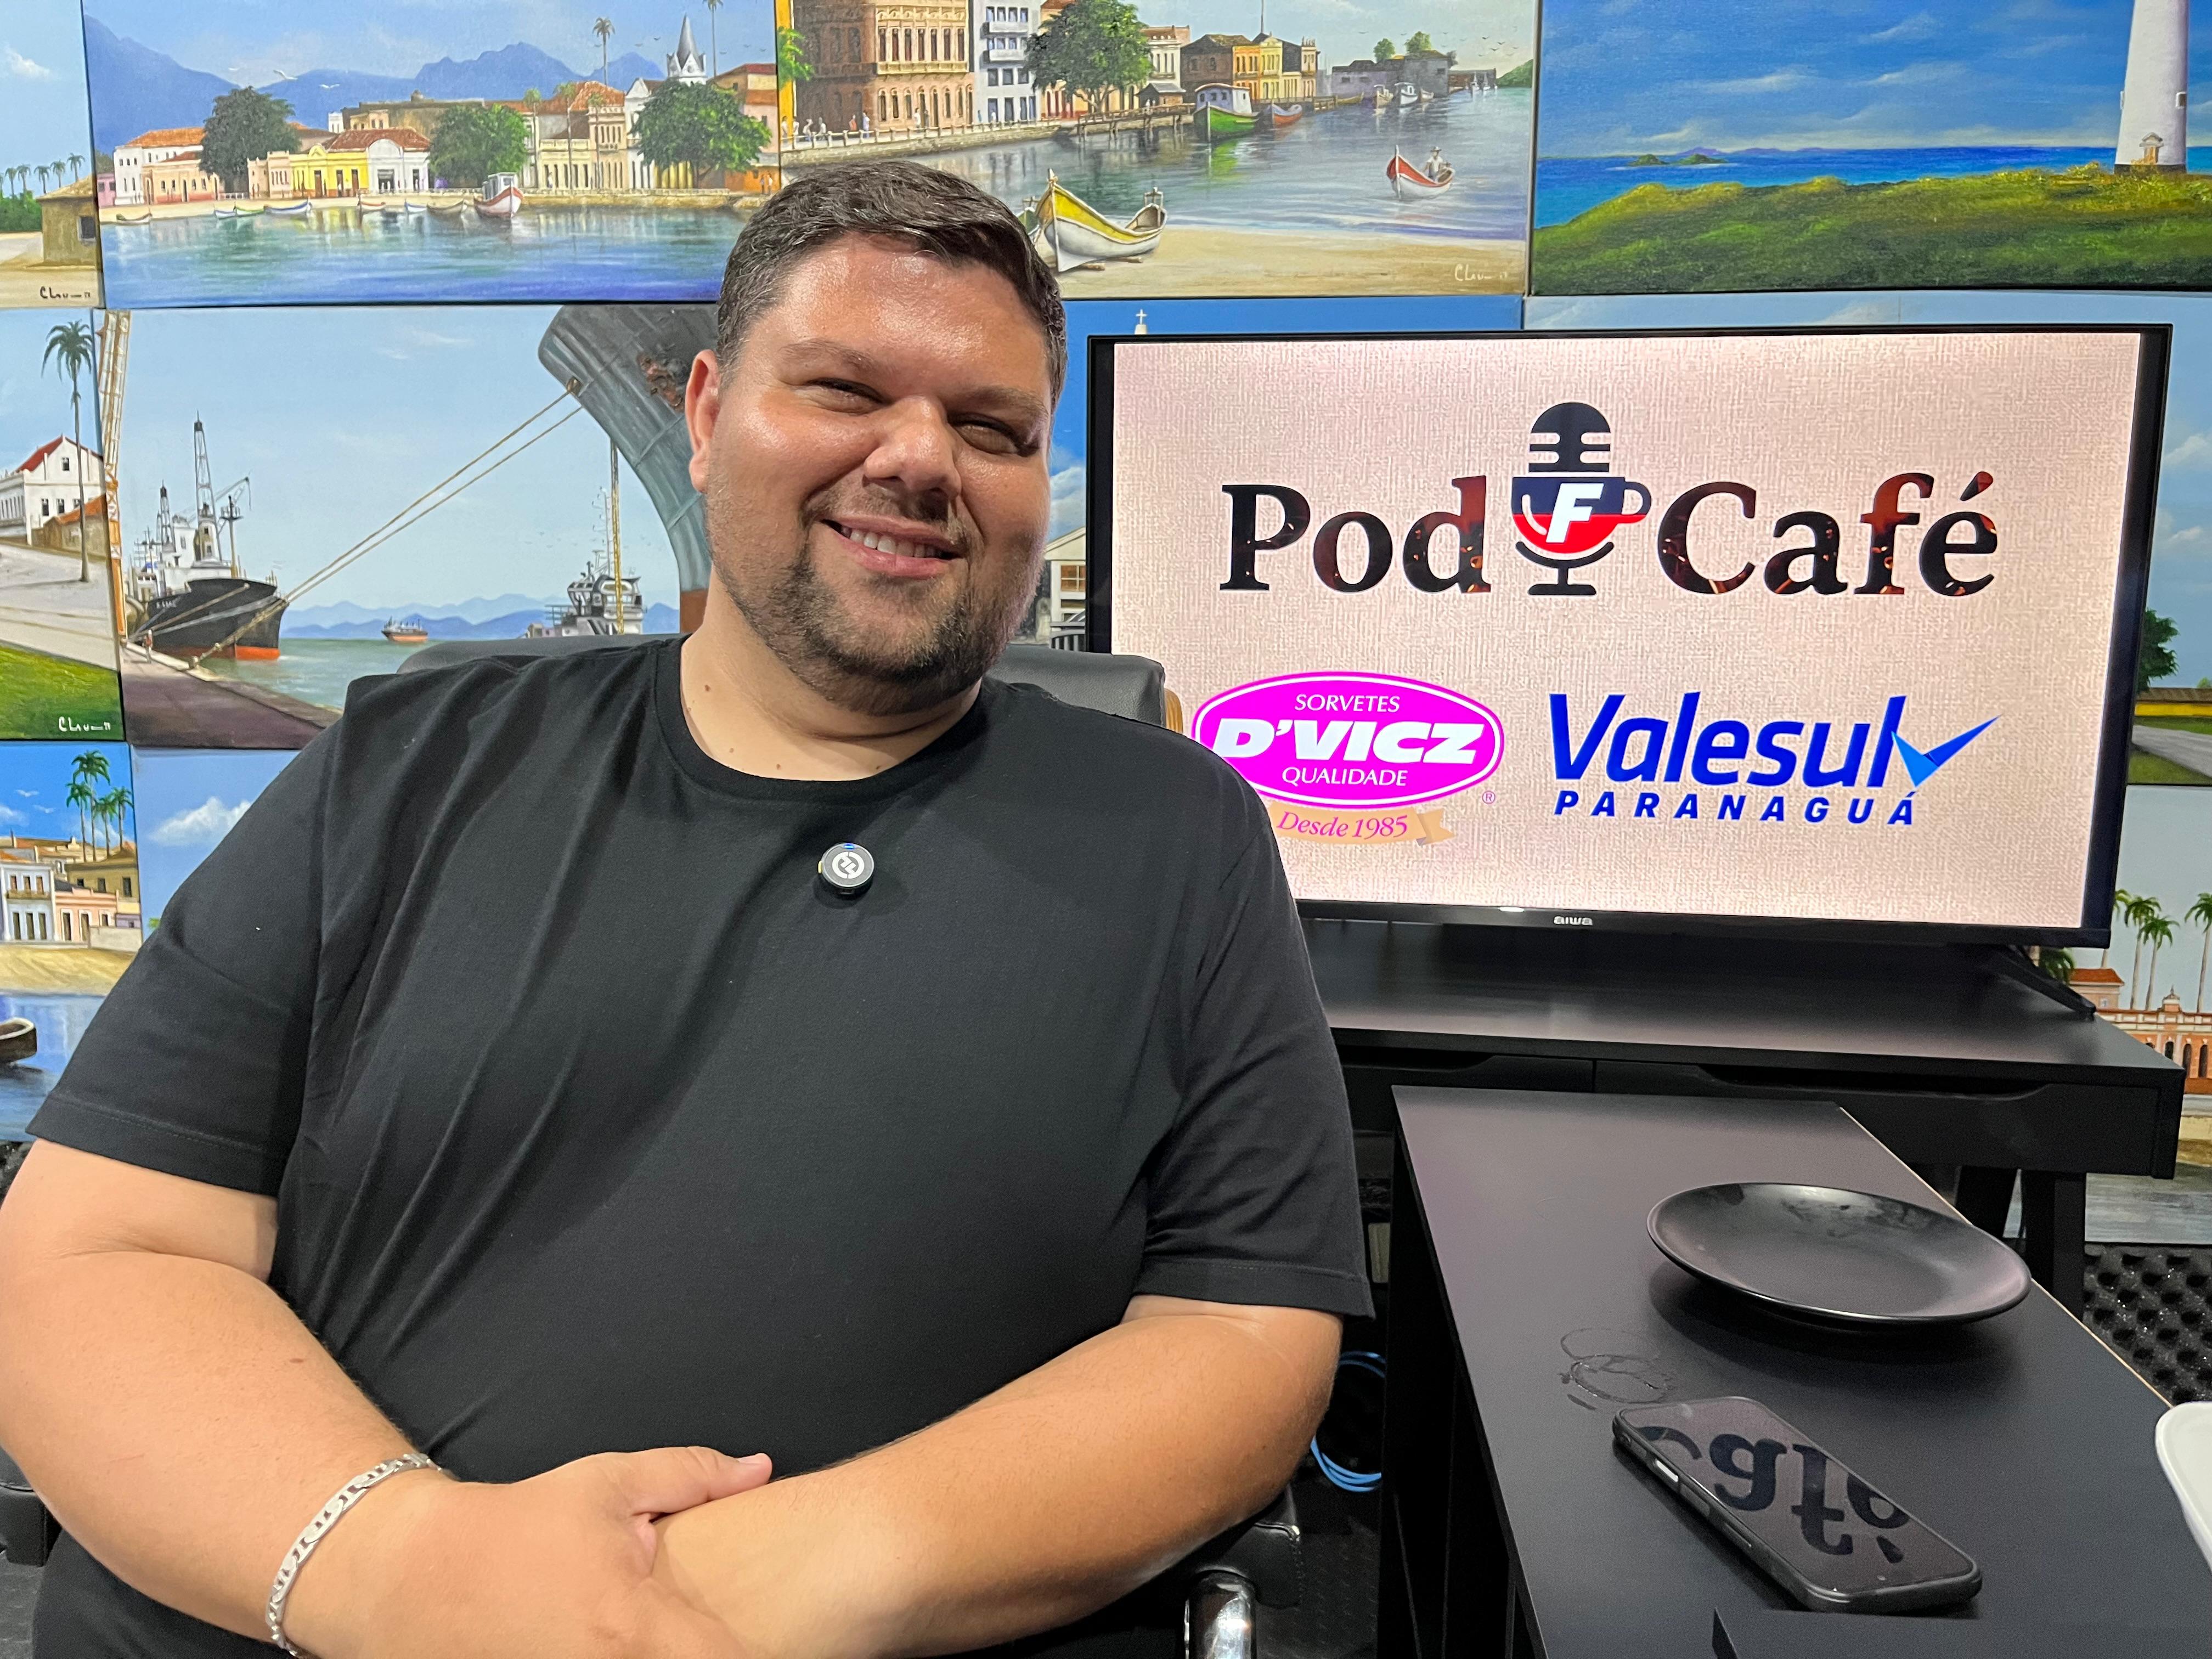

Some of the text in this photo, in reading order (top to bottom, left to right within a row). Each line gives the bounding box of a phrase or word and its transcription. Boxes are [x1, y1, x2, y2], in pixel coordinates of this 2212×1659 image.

[1546, 483, 1604, 543] F
[1220, 471, 1998, 597] Pod Café
[1294, 693, 1400, 713] SORVETES
[1212, 718, 1485, 764] D'VICZ
[1549, 691, 1906, 788] Valesul
[1282, 766, 1408, 786] QUALIDADE
[1276, 811, 1408, 840] Desde 1985
[1554, 791, 1915, 826] PARANAGUÁ
[1554, 916, 1593, 926] aiwa
